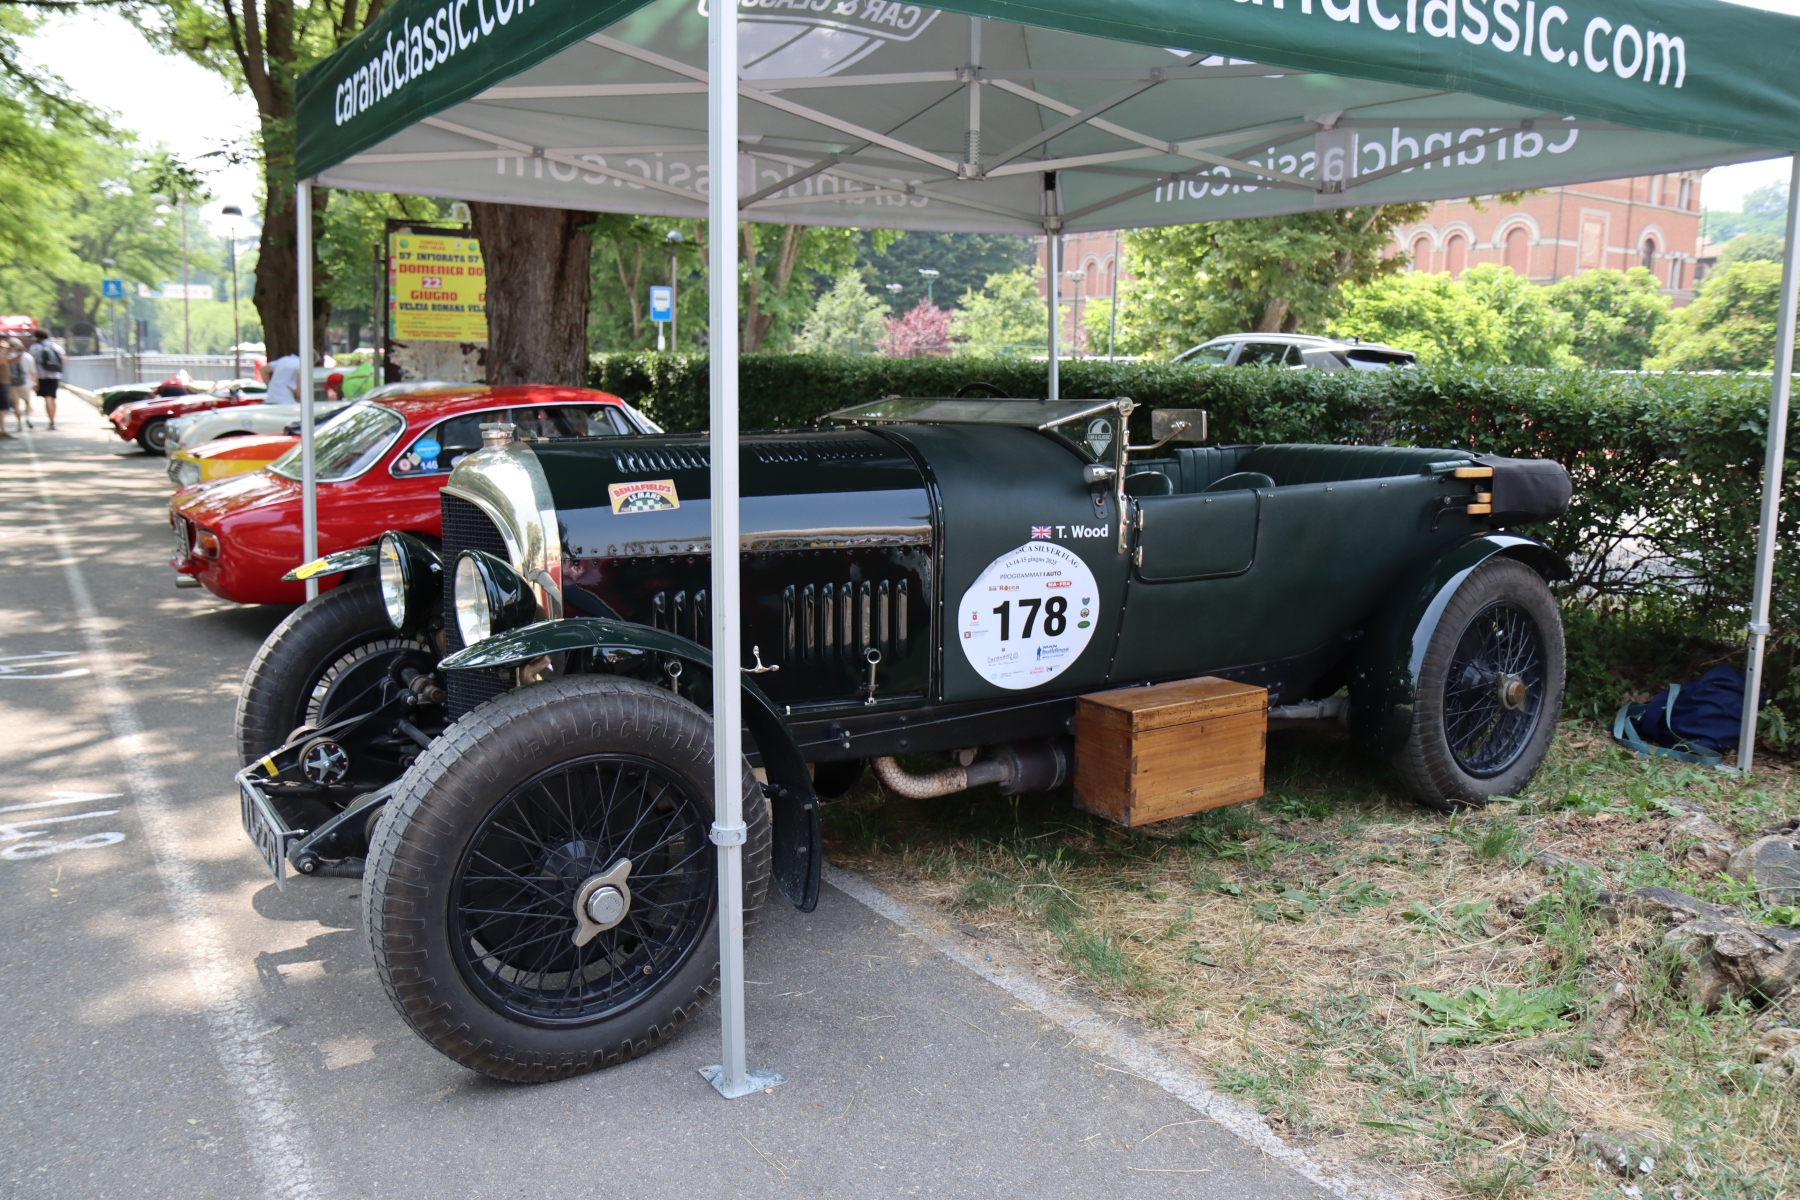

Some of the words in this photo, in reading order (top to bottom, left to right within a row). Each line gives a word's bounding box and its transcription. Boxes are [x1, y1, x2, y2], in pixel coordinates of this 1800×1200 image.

[417, 253, 465, 262] INFIORATA
[399, 264, 464, 276] DOMENICA
[422, 277, 442, 289] 22
[411, 290, 458, 301] GIUGNO
[614, 484, 671, 497] BENJAFIELD'S
[1055, 525, 1068, 539] T.
[1071, 523, 1109, 539] Wood
[1034, 545, 1061, 557] SILVER
[1061, 552, 1080, 568] FLAG
[993, 595, 1068, 642] 178
